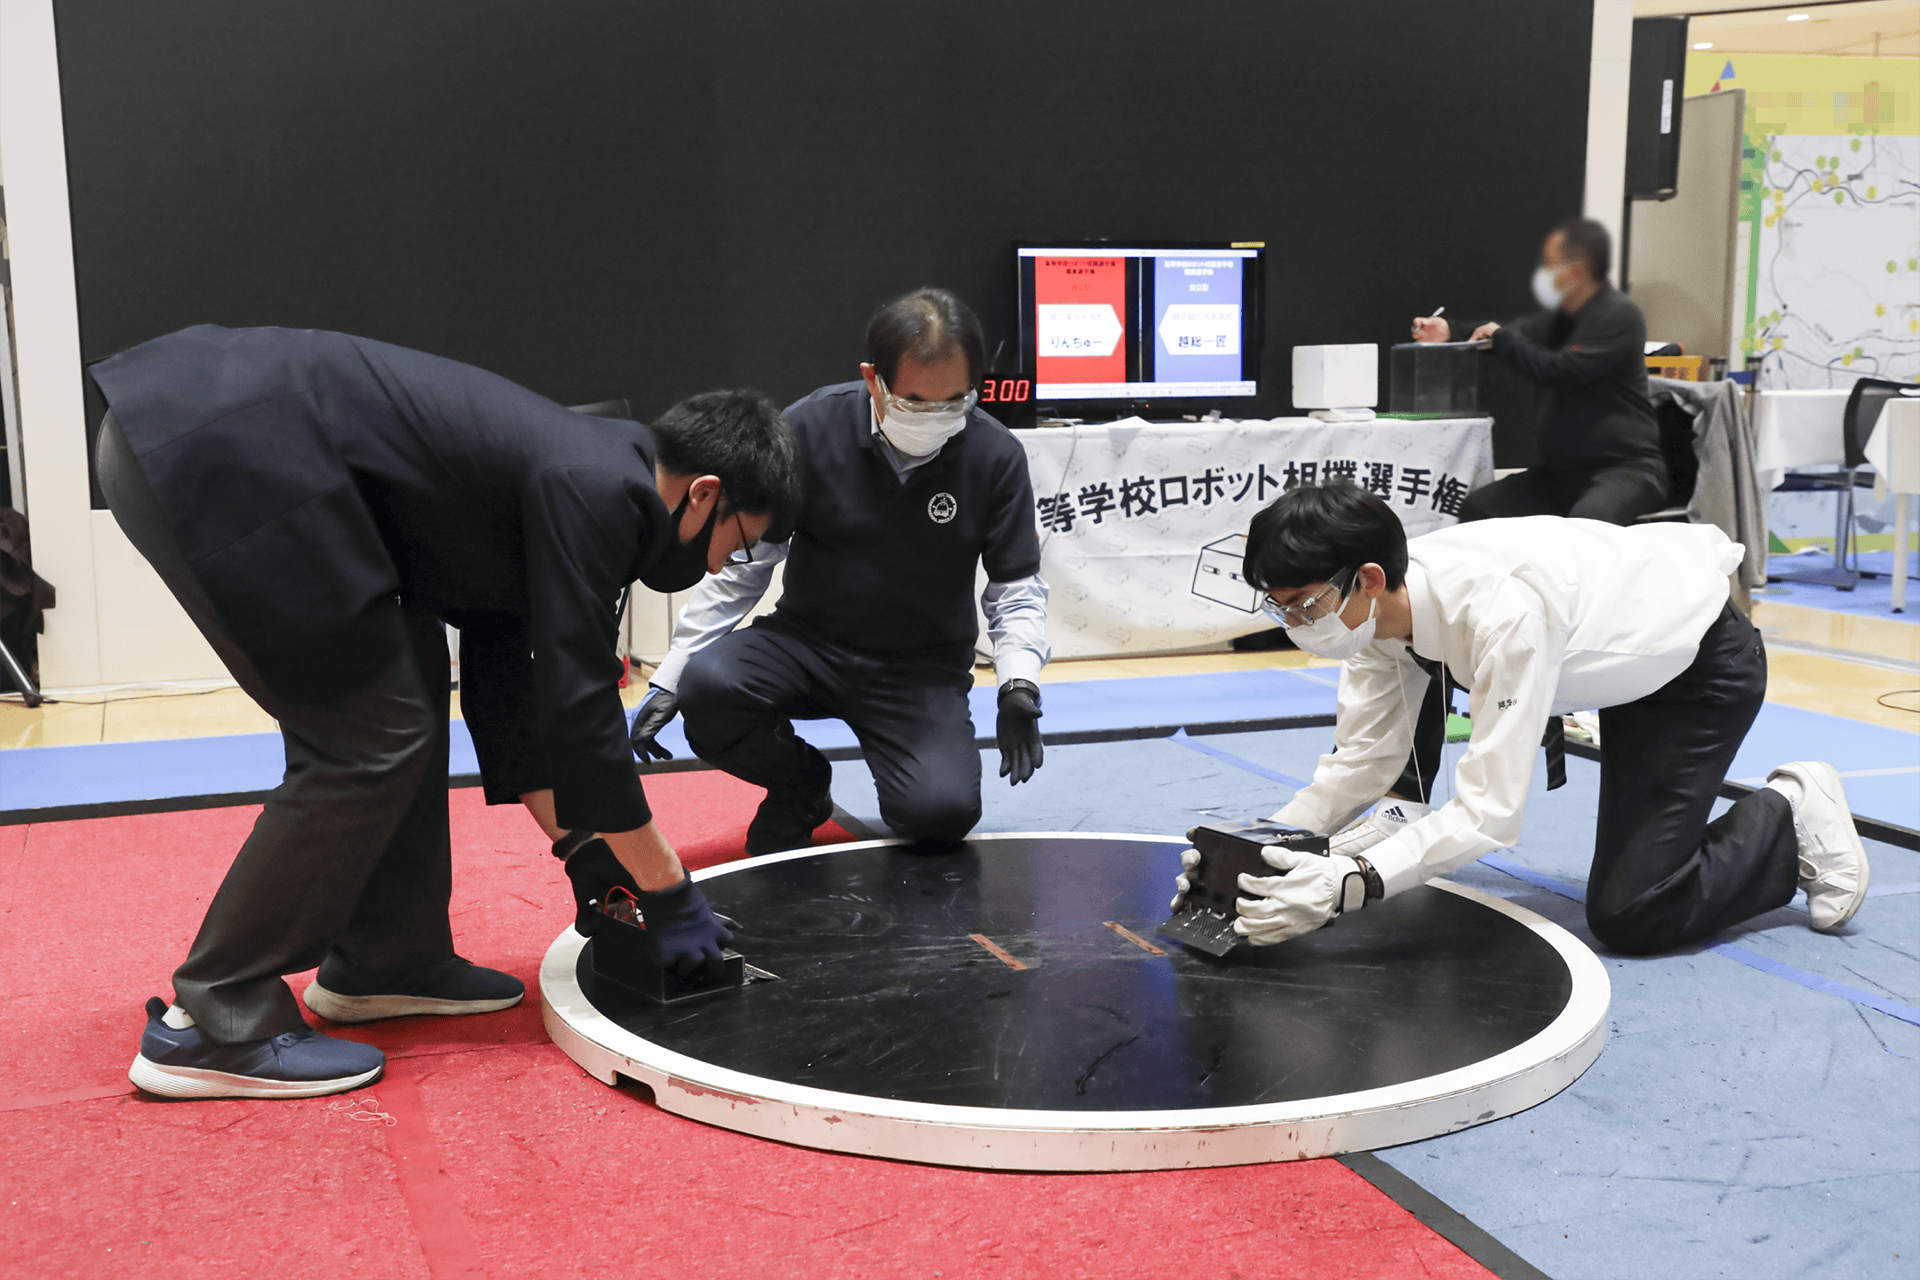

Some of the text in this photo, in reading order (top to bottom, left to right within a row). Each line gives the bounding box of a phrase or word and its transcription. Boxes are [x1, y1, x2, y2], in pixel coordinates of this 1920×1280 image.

[1051, 336, 1103, 348] りんちゅー
